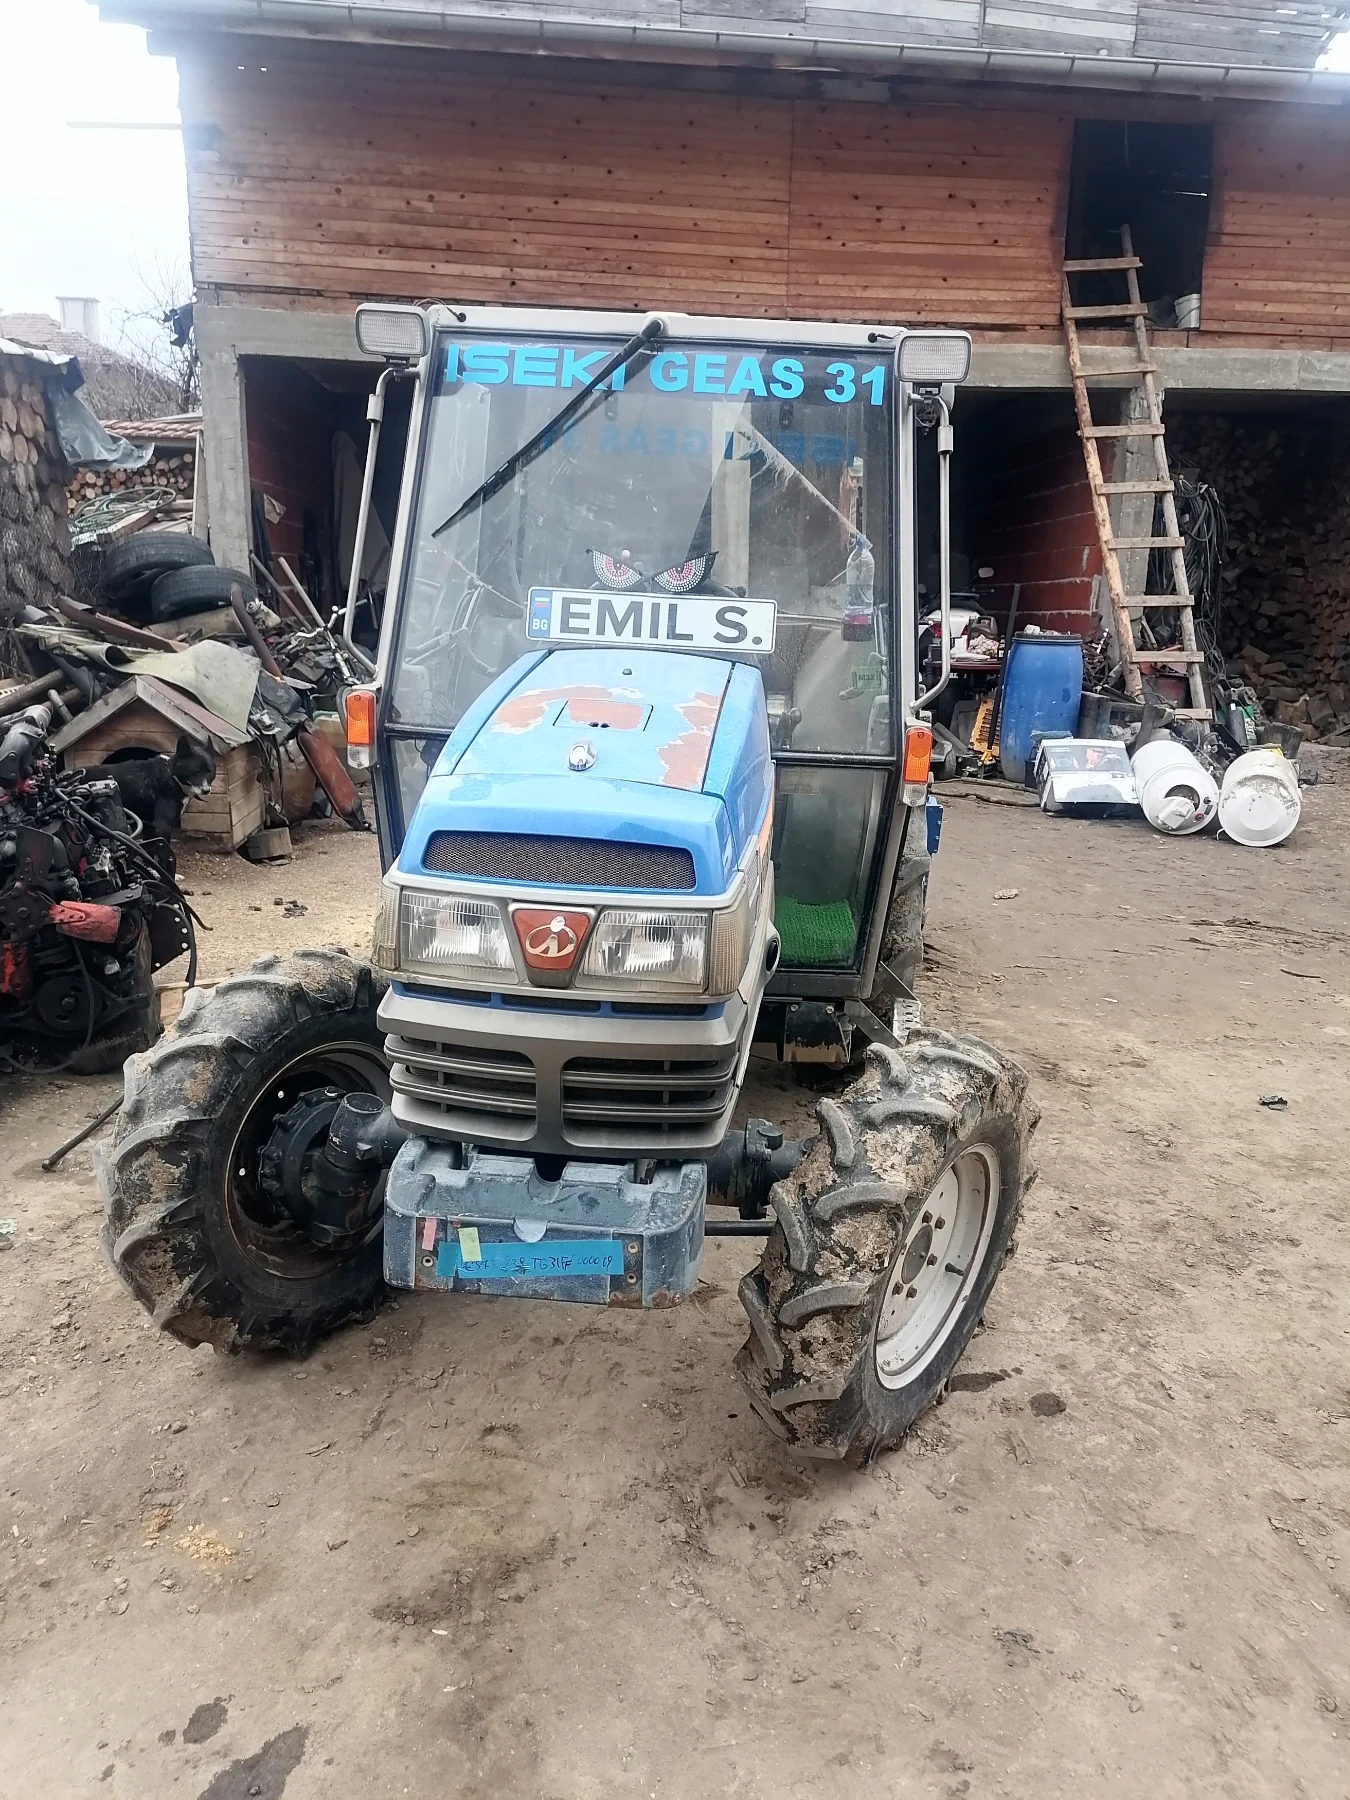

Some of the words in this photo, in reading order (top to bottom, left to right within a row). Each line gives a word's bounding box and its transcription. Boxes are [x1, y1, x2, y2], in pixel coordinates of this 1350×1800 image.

[445, 343, 626, 391] ISEKI
[650, 352, 805, 399] GEAS
[824, 362, 886, 405] 31
[532, 618, 549, 631] BG
[559, 597, 693, 641] EMIL
[713, 606, 763, 645] S.
